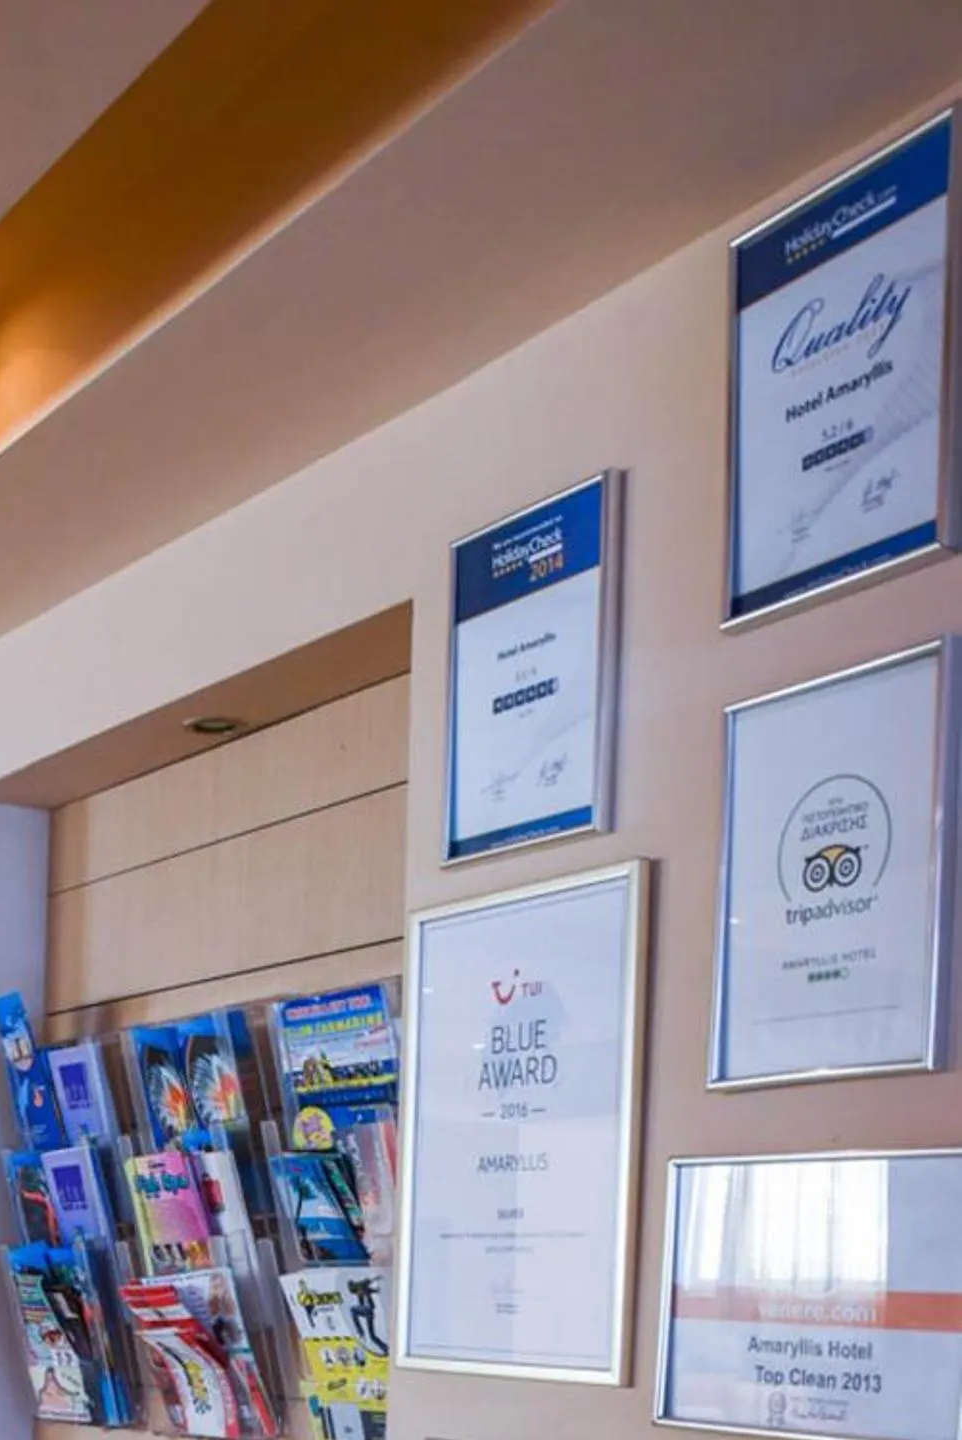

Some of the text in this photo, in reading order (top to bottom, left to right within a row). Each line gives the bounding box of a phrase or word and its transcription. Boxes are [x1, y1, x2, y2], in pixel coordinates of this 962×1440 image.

[772, 272, 912, 374] Quality
[786, 360, 893, 422] Hotel Amaryllis
[785, 897, 874, 927] tripadvisor
[522, 981, 543, 998] TUI
[491, 1019, 548, 1055] BLUE
[478, 1054, 558, 1092] AWARD
[748, 1335, 874, 1361] Amaryllis Hotel
[755, 1364, 883, 1394] Top Clean 2013
